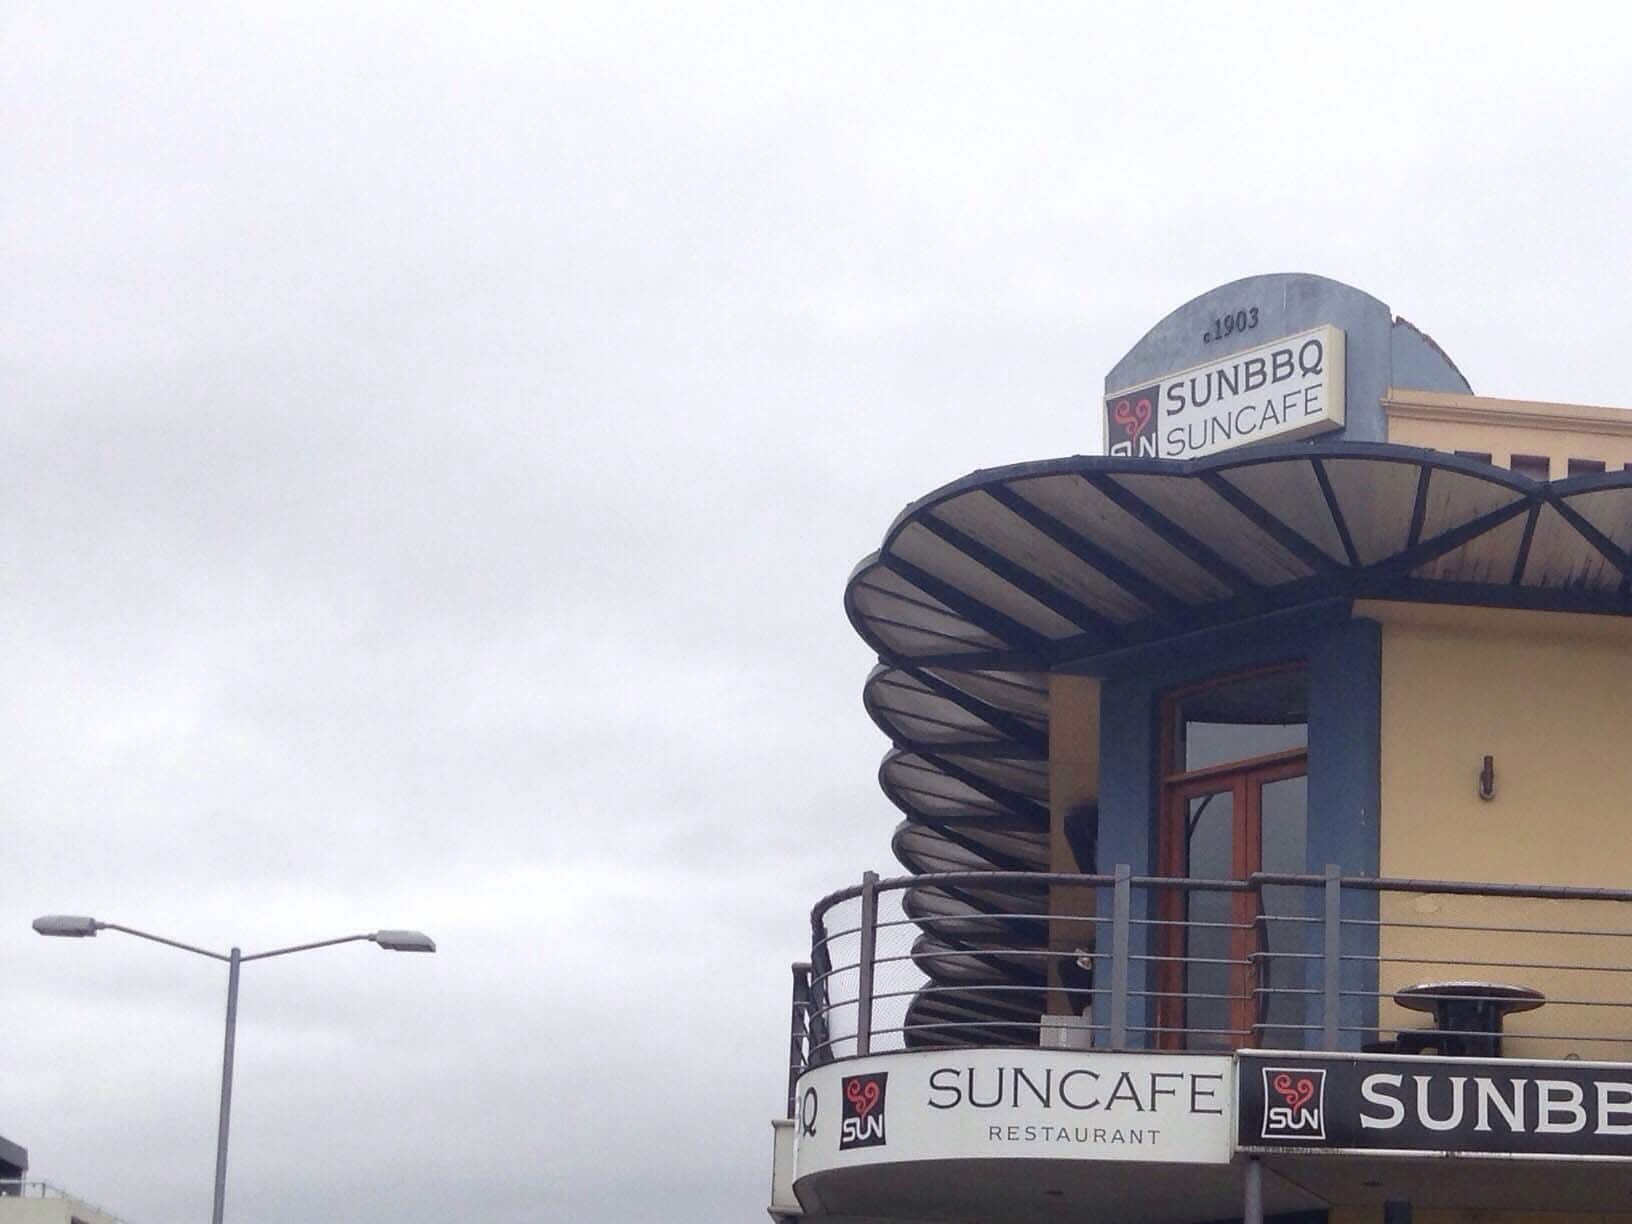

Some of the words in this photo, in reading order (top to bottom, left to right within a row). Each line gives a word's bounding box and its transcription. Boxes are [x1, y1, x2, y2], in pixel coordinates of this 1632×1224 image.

[1166, 339, 1323, 417] SUNBBQ
[1166, 383, 1323, 457] SUNCAFE
[928, 1067, 1224, 1116] SUNCAFE
[842, 1116, 884, 1141] SUN
[988, 1125, 1161, 1146] RESTAURANT
[1268, 1107, 1319, 1129] SUN
